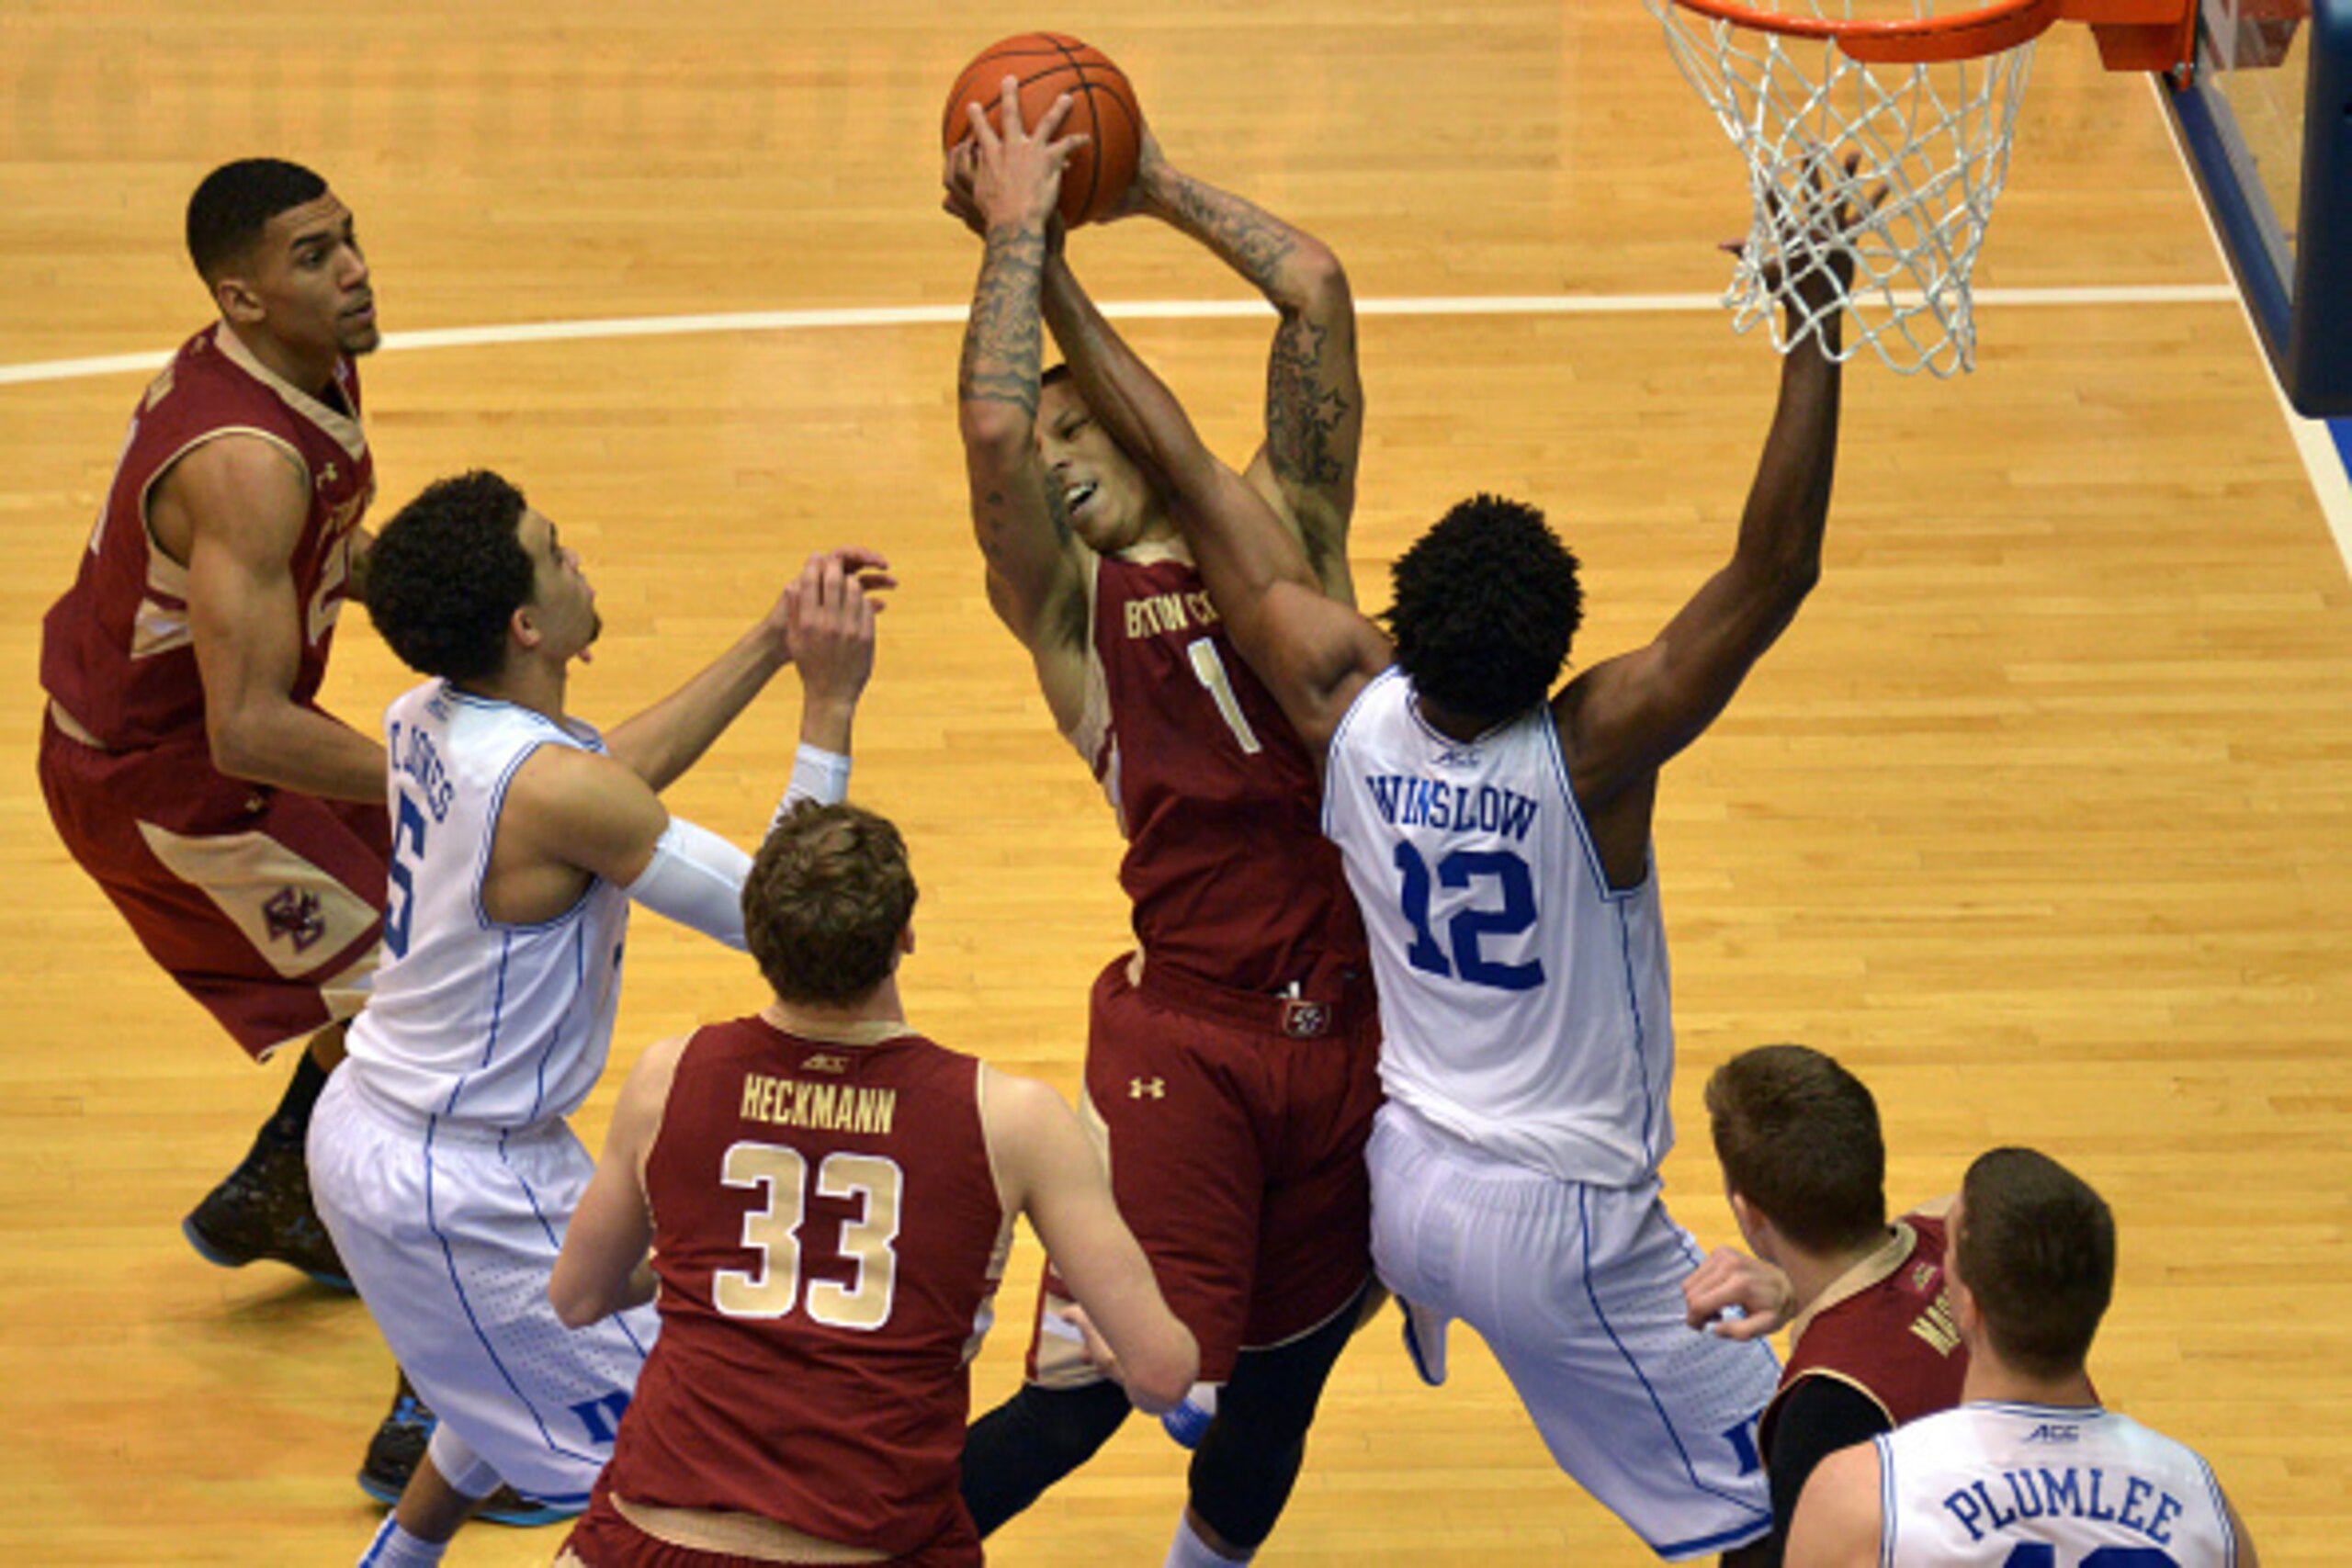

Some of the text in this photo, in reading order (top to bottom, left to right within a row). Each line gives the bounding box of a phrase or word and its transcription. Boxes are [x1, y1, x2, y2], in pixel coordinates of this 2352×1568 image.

[1188, 637, 1261, 754] 1
[1365, 775, 1538, 841] WINSLOW
[383, 786, 426, 962] 5
[1394, 840, 1545, 990] 12
[740, 1073, 896, 1134] HECKMANN
[712, 1140, 903, 1331] 33
[2024, 1424, 2080, 1442] ACC
[1942, 1467, 2183, 1542] PLUMLEE
